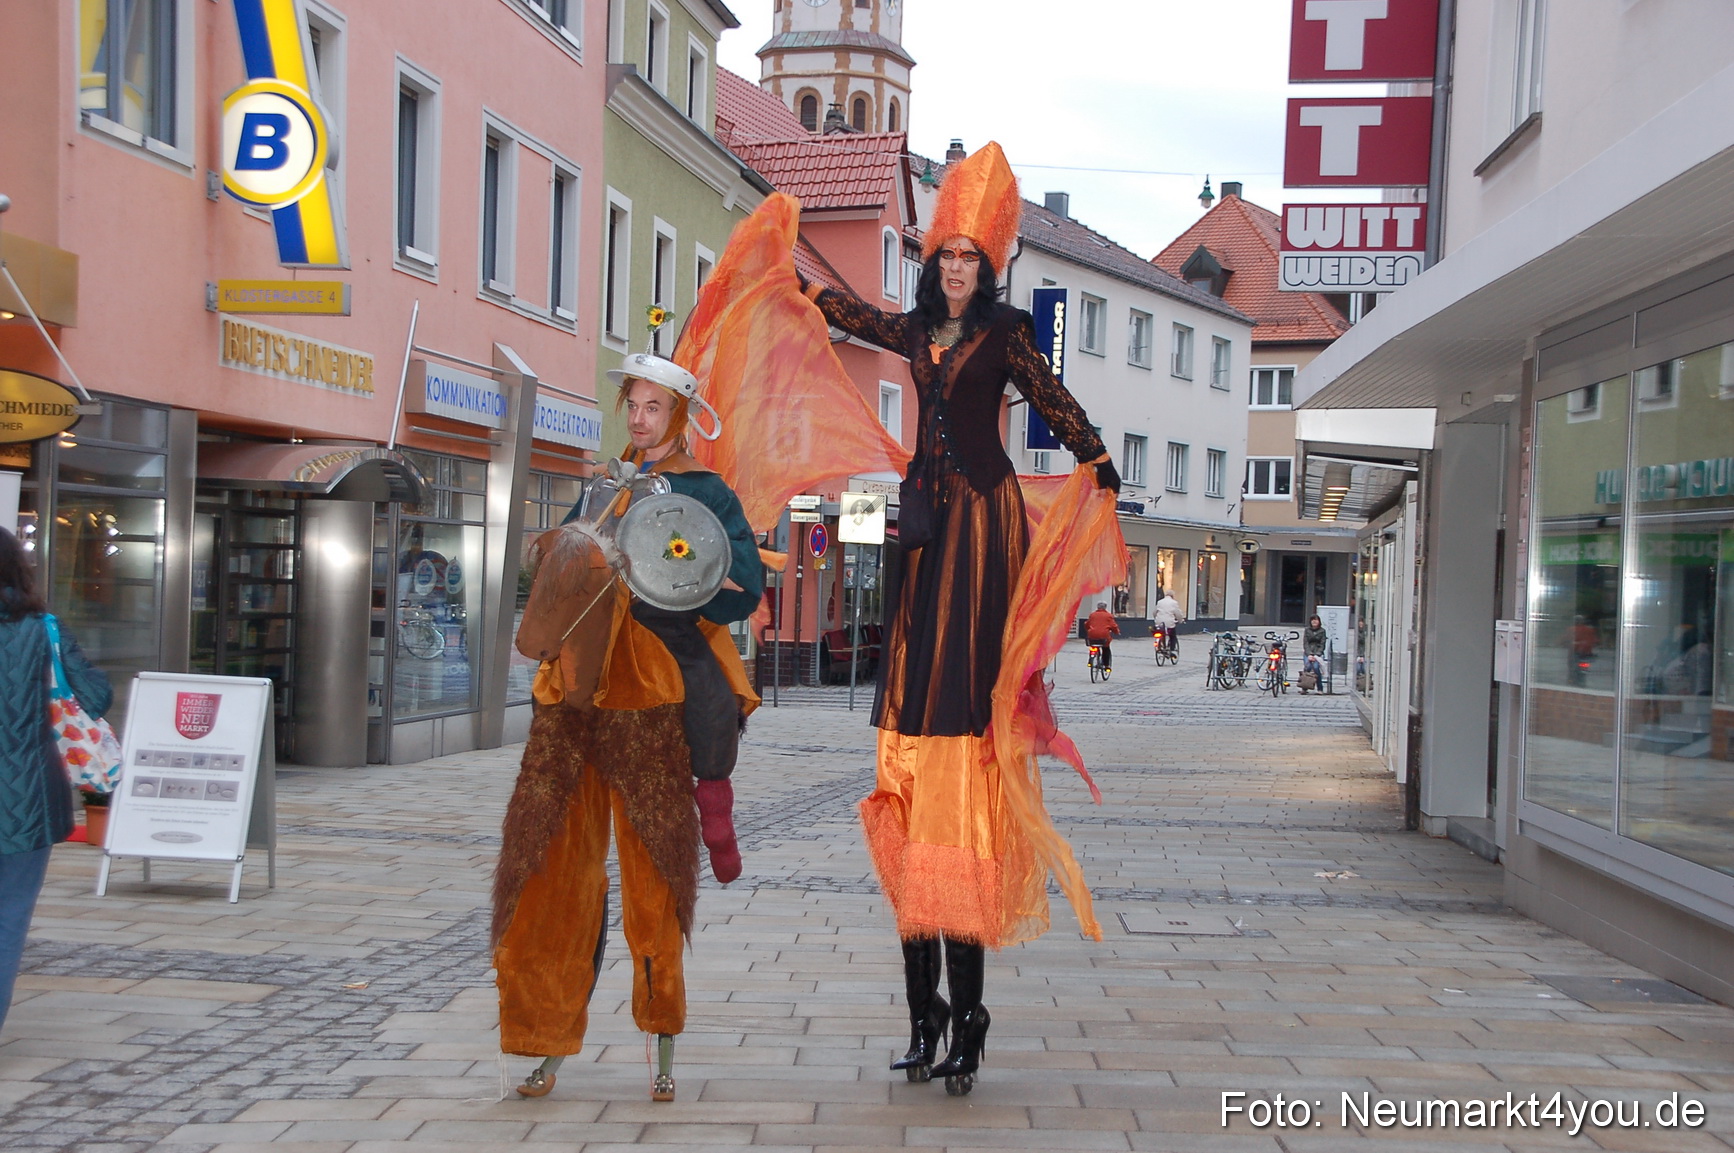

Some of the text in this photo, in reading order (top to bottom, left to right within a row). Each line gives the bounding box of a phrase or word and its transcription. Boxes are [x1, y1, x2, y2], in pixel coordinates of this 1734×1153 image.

[234, 112, 291, 171] B
[1287, 207, 1421, 249] WITT
[1283, 255, 1420, 286] WEIDEN
[225, 289, 336, 304] KLOSTERGASSE 4
[1052, 301, 1065, 376] TAILOR
[223, 319, 375, 392] BRETSCHNEIDER
[427, 375, 508, 418] KOMMUNIKATION
[180, 705, 214, 714] WIEDER
[182, 698, 214, 706] IMMER
[180, 713, 210, 724] NEU
[180, 724, 209, 732] MARKT
